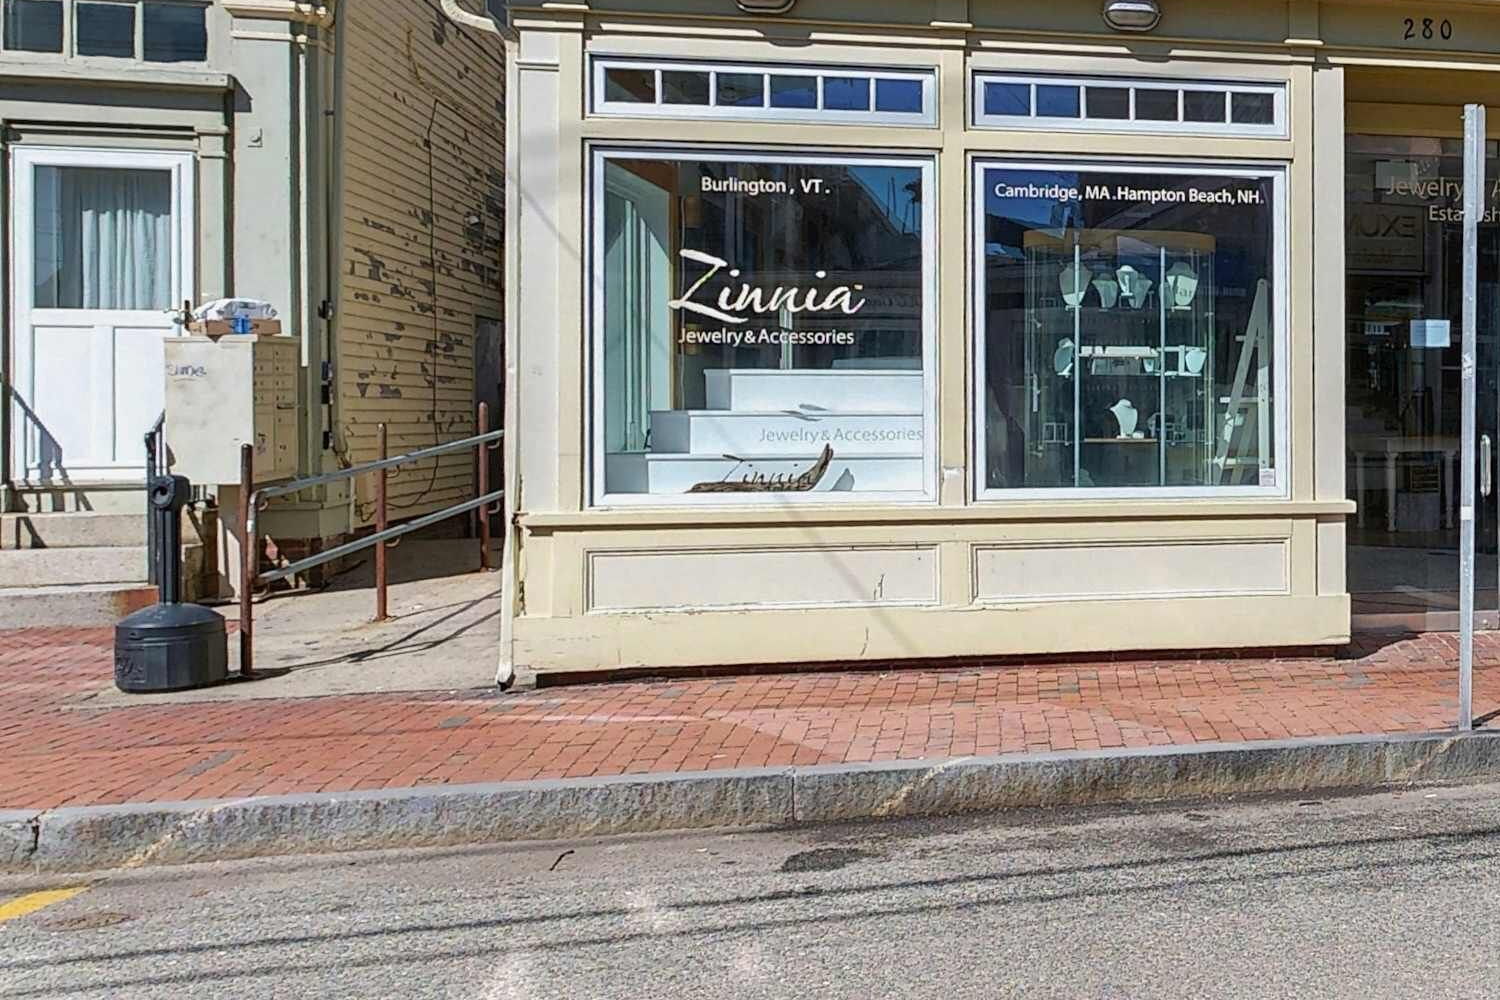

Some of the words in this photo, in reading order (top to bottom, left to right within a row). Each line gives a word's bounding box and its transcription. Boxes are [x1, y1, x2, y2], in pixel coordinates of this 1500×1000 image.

[1403, 18, 1452, 40] 280
[994, 183, 1083, 201] Cambridge,
[1188, 188, 1235, 205] Beach,
[1385, 175, 1464, 202] Jewelry
[667, 248, 866, 324] Zinnia
